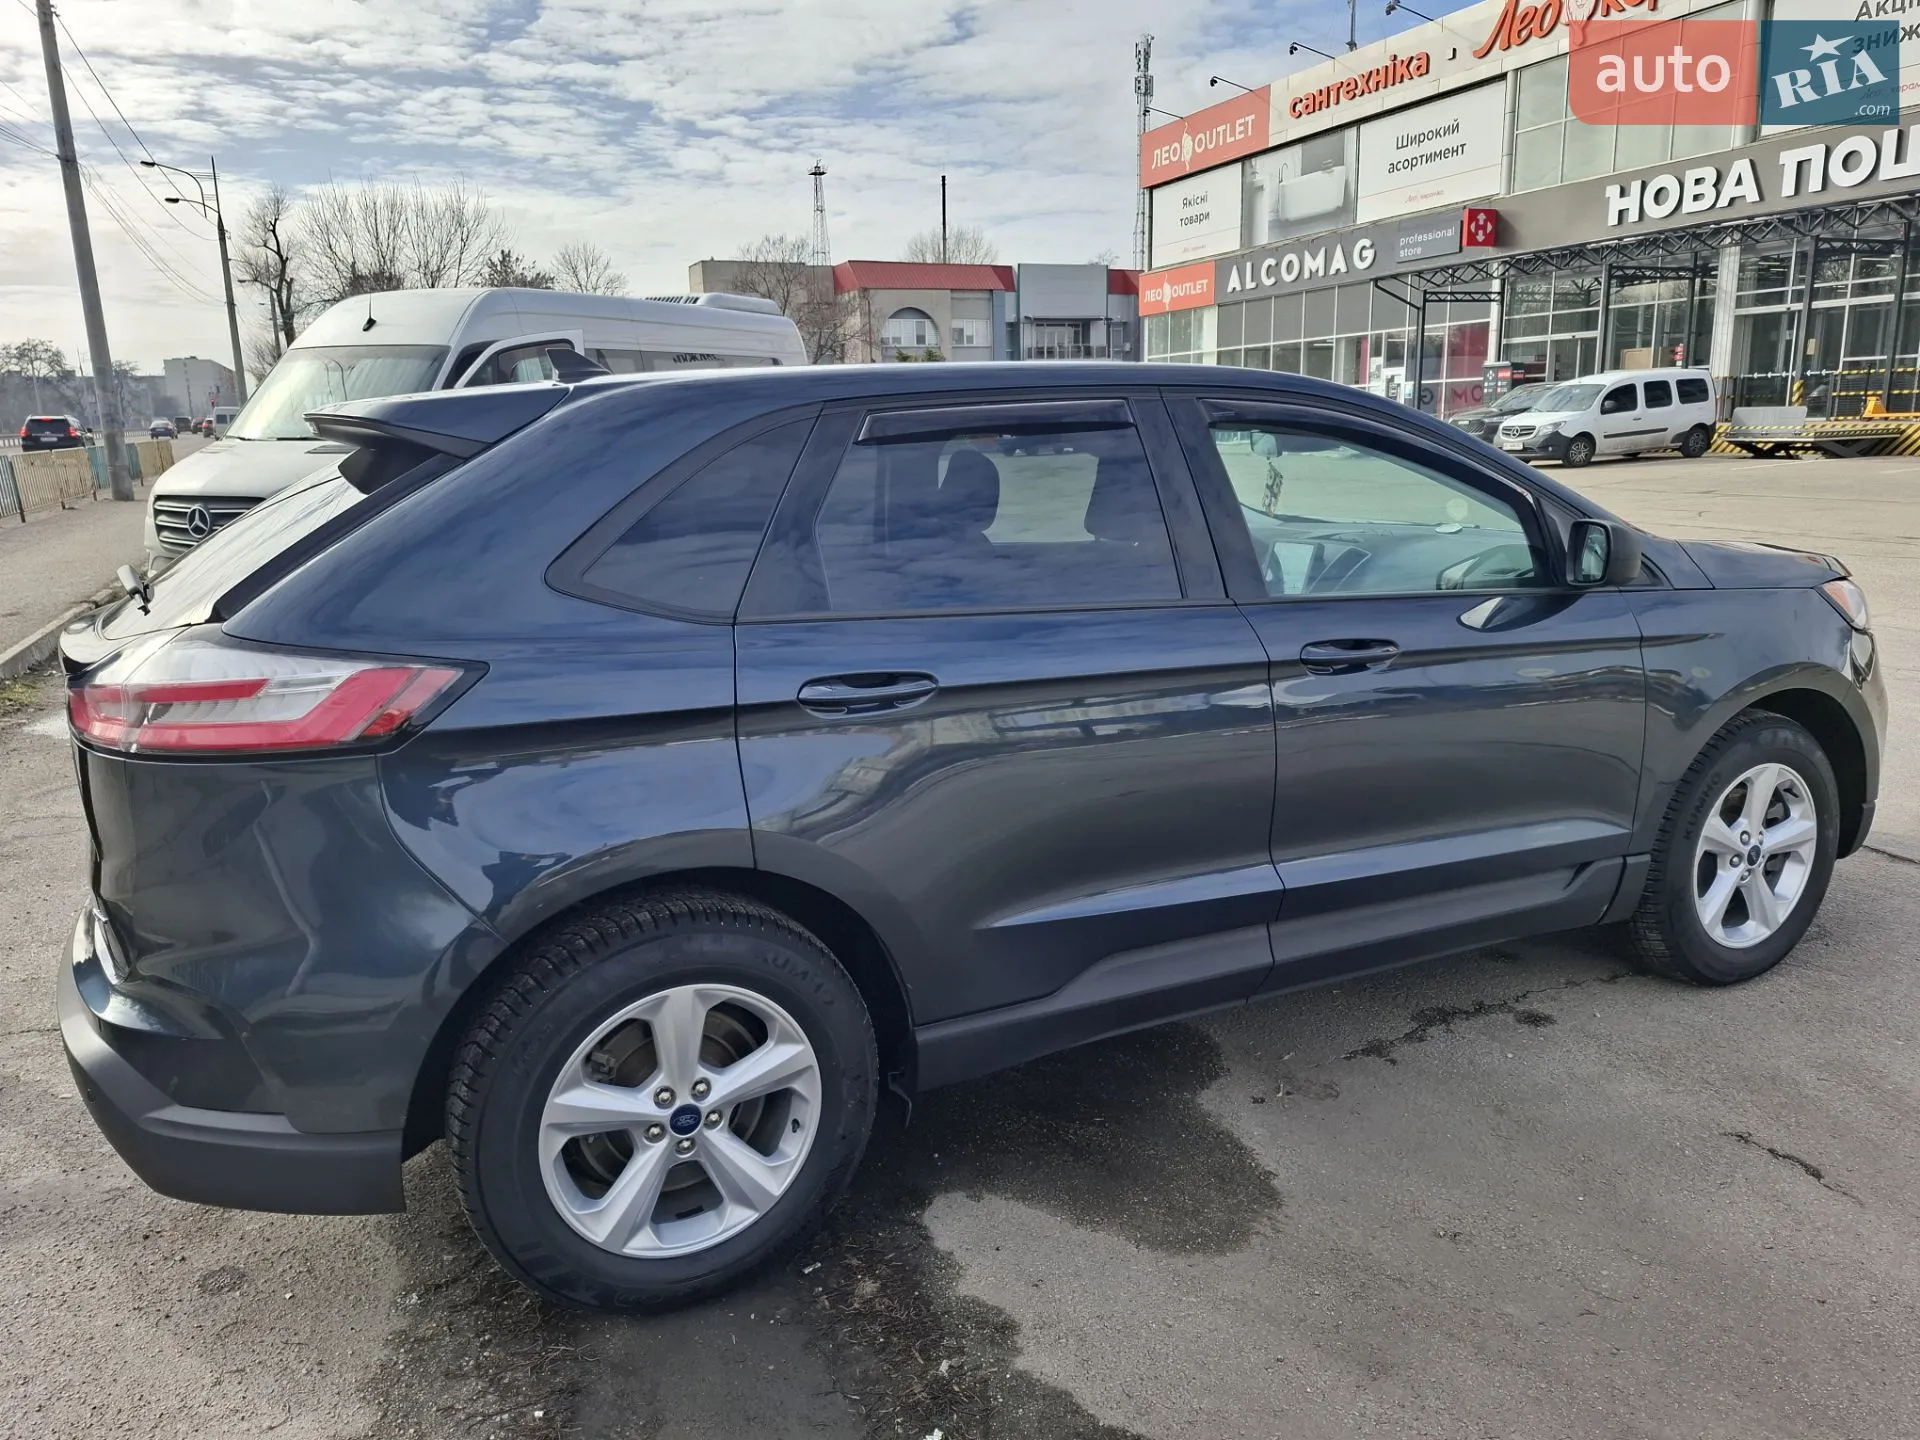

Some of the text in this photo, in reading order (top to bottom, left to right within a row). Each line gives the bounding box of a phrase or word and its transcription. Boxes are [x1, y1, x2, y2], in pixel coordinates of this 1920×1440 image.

[1289, 51, 1430, 118] сантехніка
[1151, 114, 1256, 170] ЛЕО OUTLET
[1395, 118, 1461, 151] Широкий
[1387, 142, 1467, 174] асортимент
[1182, 191, 1209, 210] Якісні
[1605, 158, 1762, 226] НОВА
[1179, 211, 1210, 228] товари
[1399, 227, 1456, 247] professional
[1399, 247, 1422, 258] store
[1227, 238, 1377, 294] ALCOMAG
[1144, 279, 1209, 304] ЛЕО OUTLET
